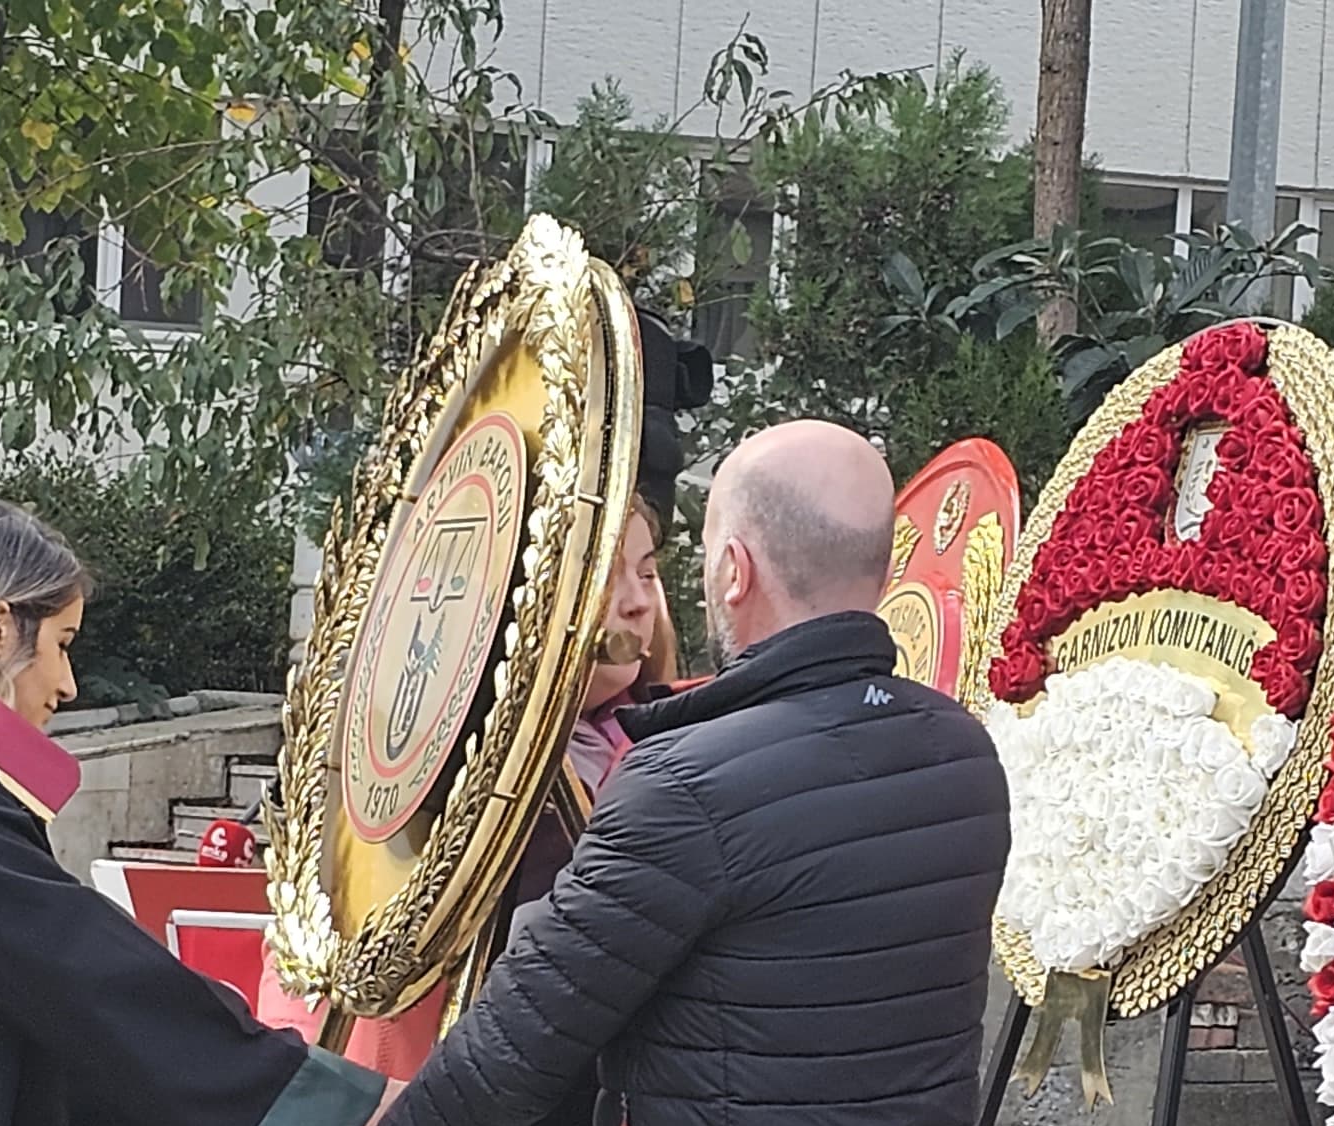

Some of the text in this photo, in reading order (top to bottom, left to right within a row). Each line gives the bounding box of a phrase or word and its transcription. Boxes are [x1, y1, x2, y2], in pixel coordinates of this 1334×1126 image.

[1055, 608, 1262, 680] GARNİZON KOMUTANLIĞ
[364, 782, 399, 819] 1970
